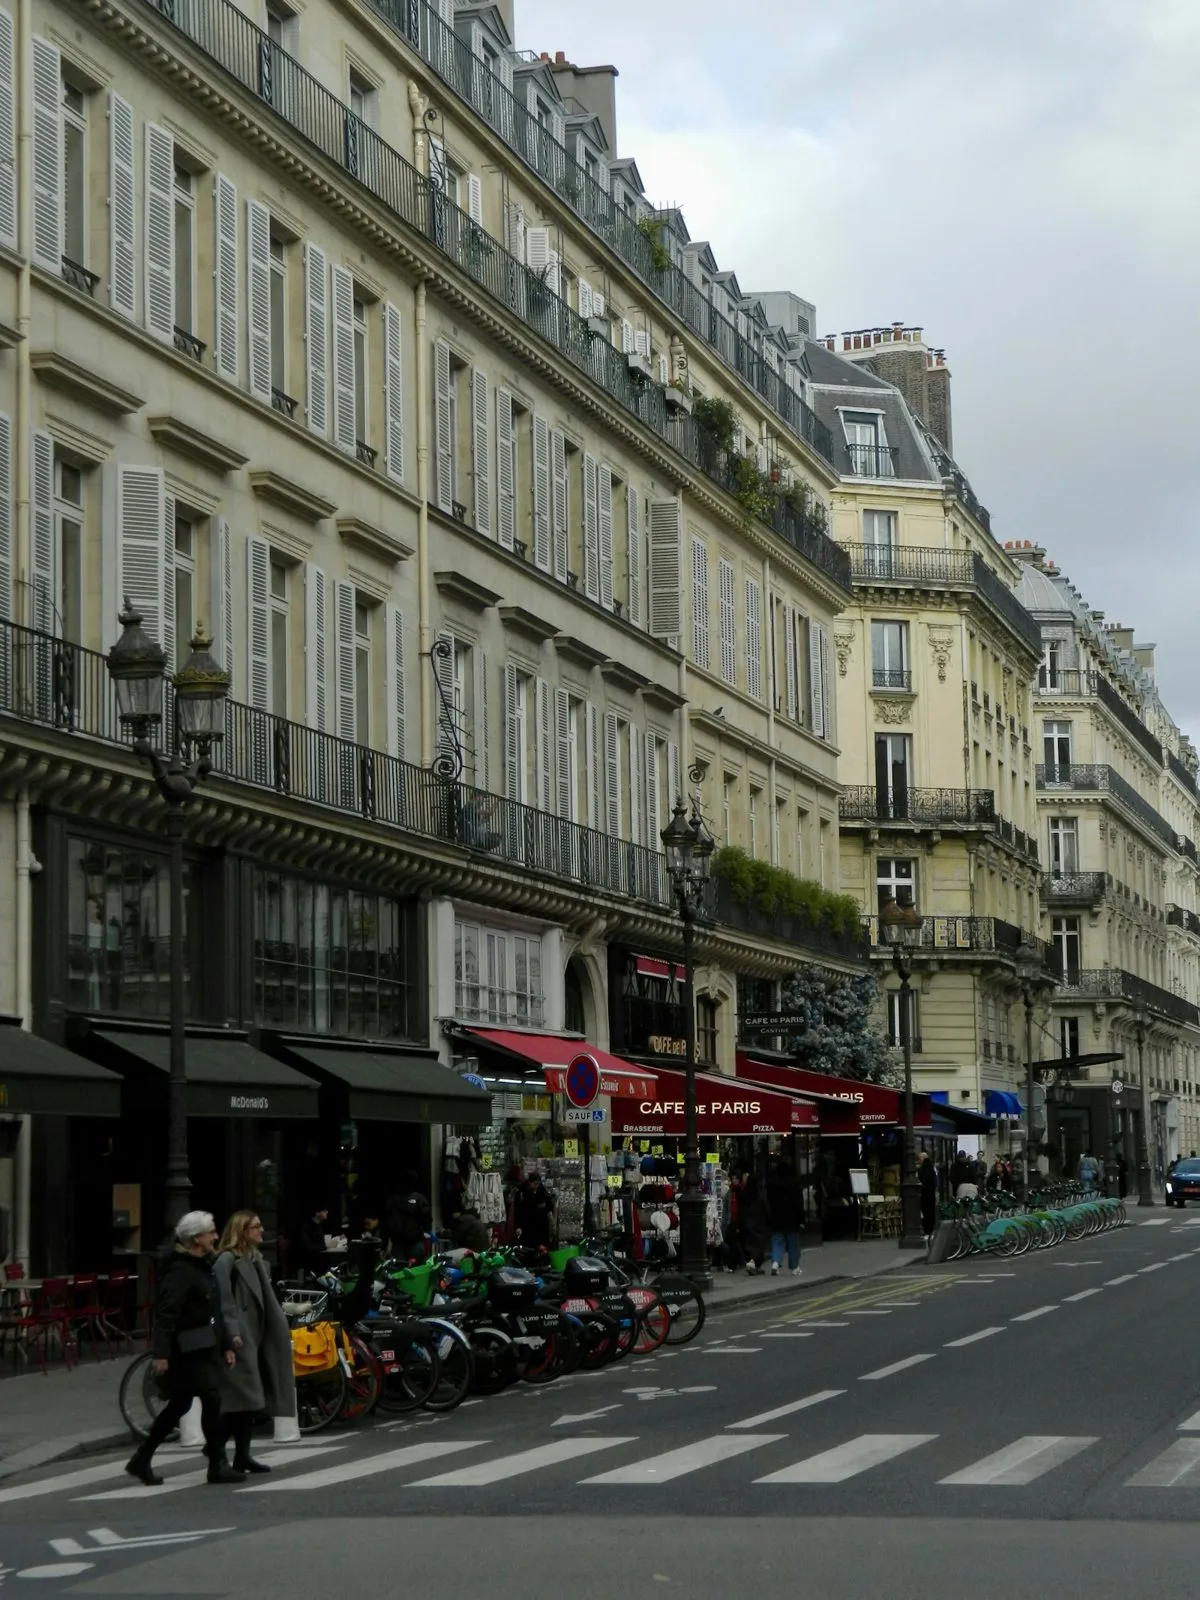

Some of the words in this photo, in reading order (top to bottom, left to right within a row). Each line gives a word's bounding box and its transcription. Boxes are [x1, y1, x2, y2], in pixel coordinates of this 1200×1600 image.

[745, 1017, 768, 1025] CAFE
[779, 1016, 805, 1024] PARIS
[653, 1035, 672, 1053] CAFE
[230, 1095, 269, 1109] McDonald's
[823, 1092, 864, 1103] RIS
[639, 1102, 685, 1115] CAFE
[711, 1101, 761, 1115] PARIS
[568, 1112, 591, 1120] SAUF
[623, 1124, 664, 1132] BRASSERIE
[752, 1124, 775, 1132] PIZZA
[567, 1140, 573, 1148] 3
